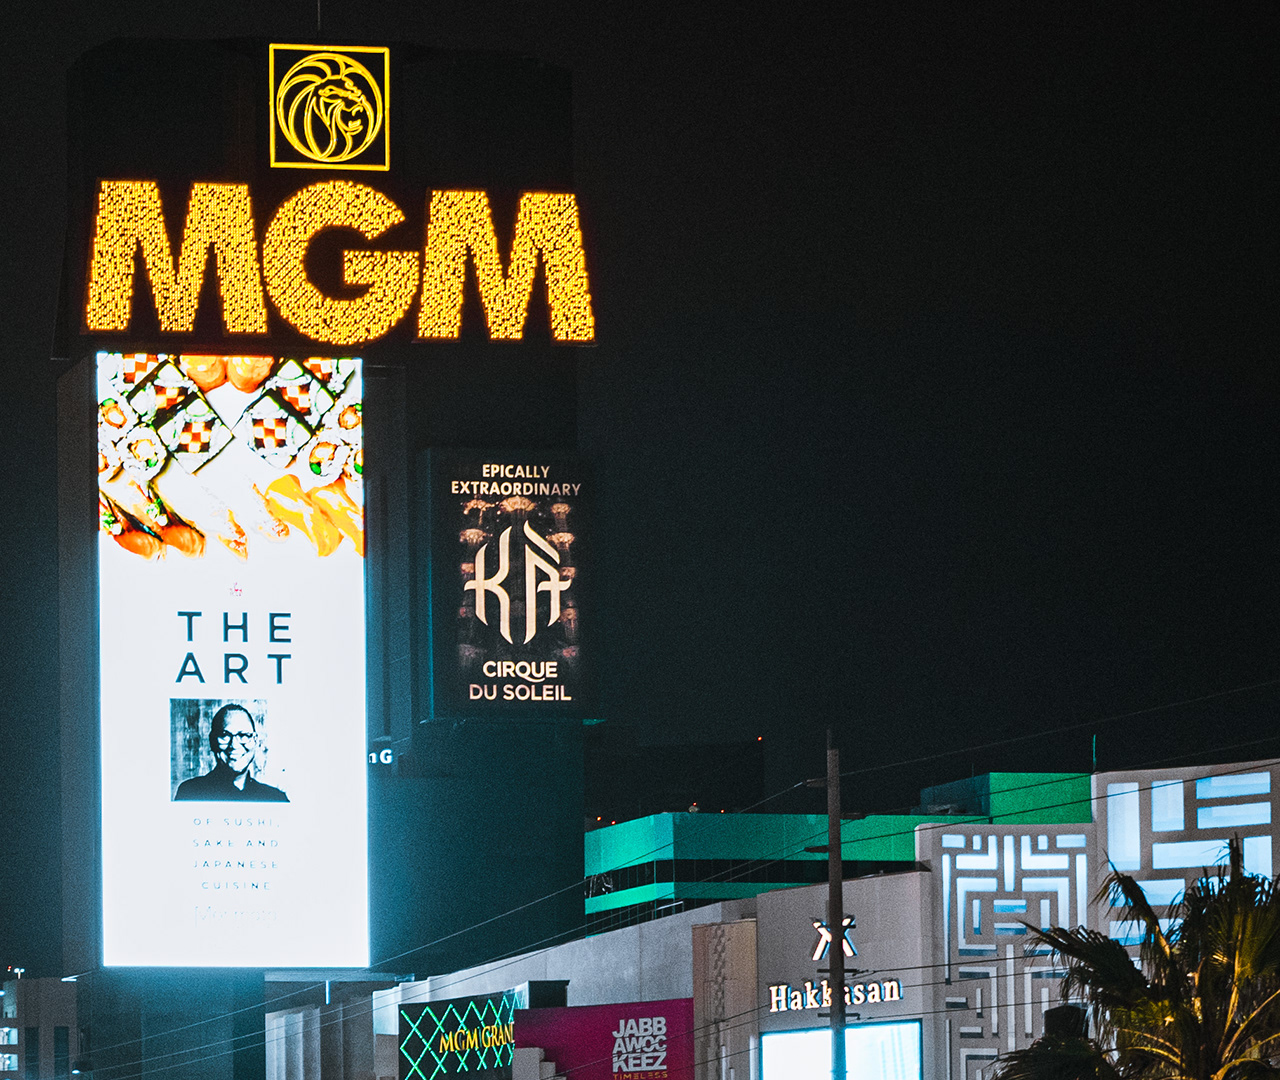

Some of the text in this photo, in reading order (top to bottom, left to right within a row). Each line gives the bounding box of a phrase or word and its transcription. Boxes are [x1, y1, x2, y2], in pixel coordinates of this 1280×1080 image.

[86, 180, 595, 345] MGM
[482, 464, 550, 479] EPICALLY
[451, 481, 581, 497] EXTRAORDINARY
[177, 611, 291, 643] THE
[175, 652, 291, 684] ART
[483, 661, 558, 682] CIRQUE
[470, 684, 572, 701] DU SOLEIL
[192, 839, 279, 848] SAKE AND
[193, 860, 278, 869] JAPANESE
[201, 881, 271, 890] CUISINE
[612, 1016, 667, 1039] JABB
[439, 1027, 479, 1053] MGM
[612, 1051, 667, 1073] KEEZ
